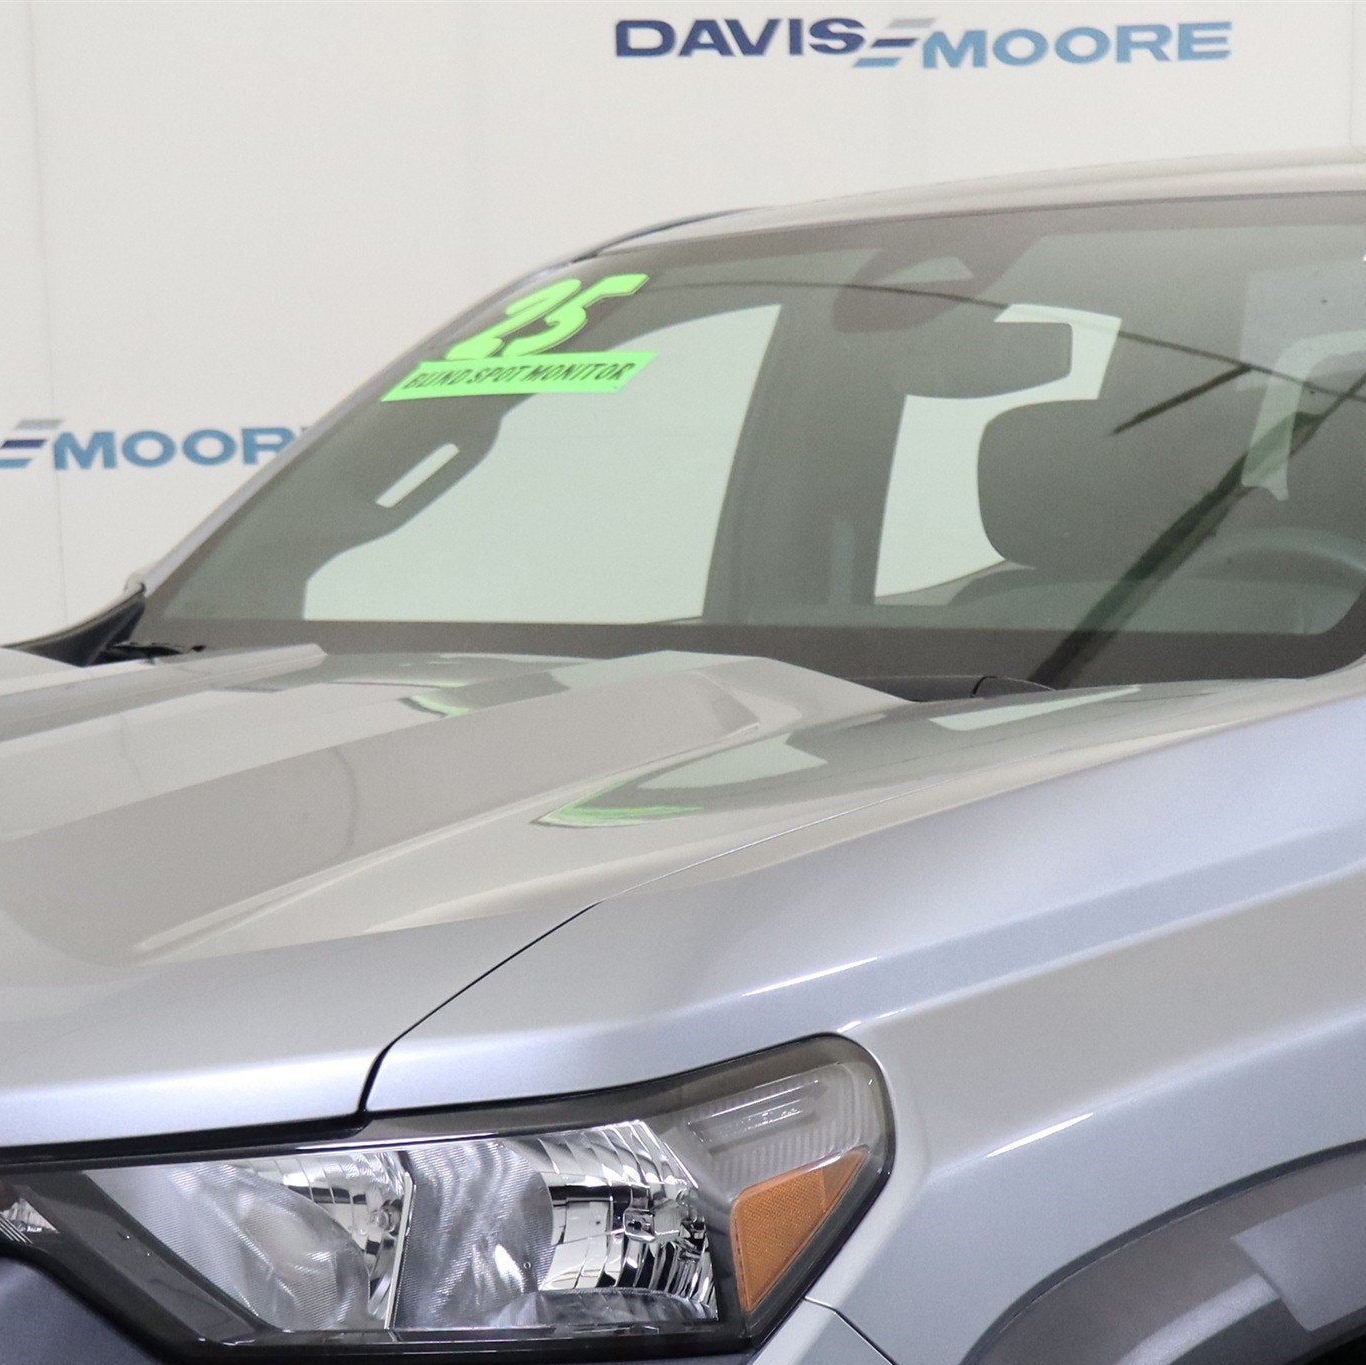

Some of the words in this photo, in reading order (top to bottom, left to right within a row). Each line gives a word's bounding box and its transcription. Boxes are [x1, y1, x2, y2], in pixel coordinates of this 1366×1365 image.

[614, 16, 866, 59] DAVIS
[922, 20, 1233, 69] MOORE
[445, 272, 650, 361] 25
[402, 369, 473, 390] BLIND
[467, 364, 529, 385] SPOT
[521, 362, 637, 383] MONITOR
[51, 424, 309, 471] MOOR
